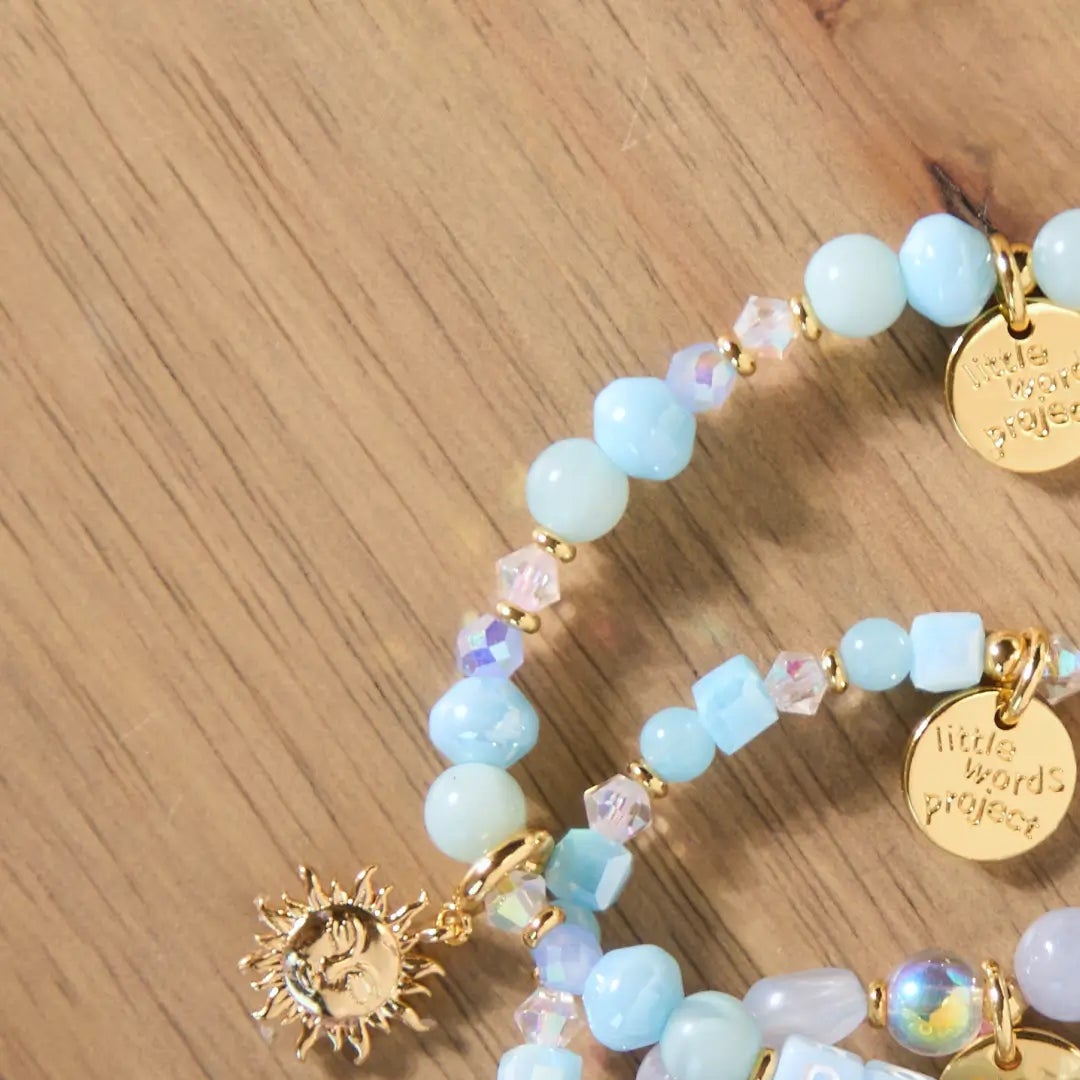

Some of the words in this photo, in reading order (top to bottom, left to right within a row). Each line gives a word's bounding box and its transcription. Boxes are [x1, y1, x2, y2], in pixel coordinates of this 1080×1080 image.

[963, 343, 1048, 389] little
[935, 725, 1016, 762] little
[964, 757, 1065, 796] words
[923, 787, 1040, 839] project
